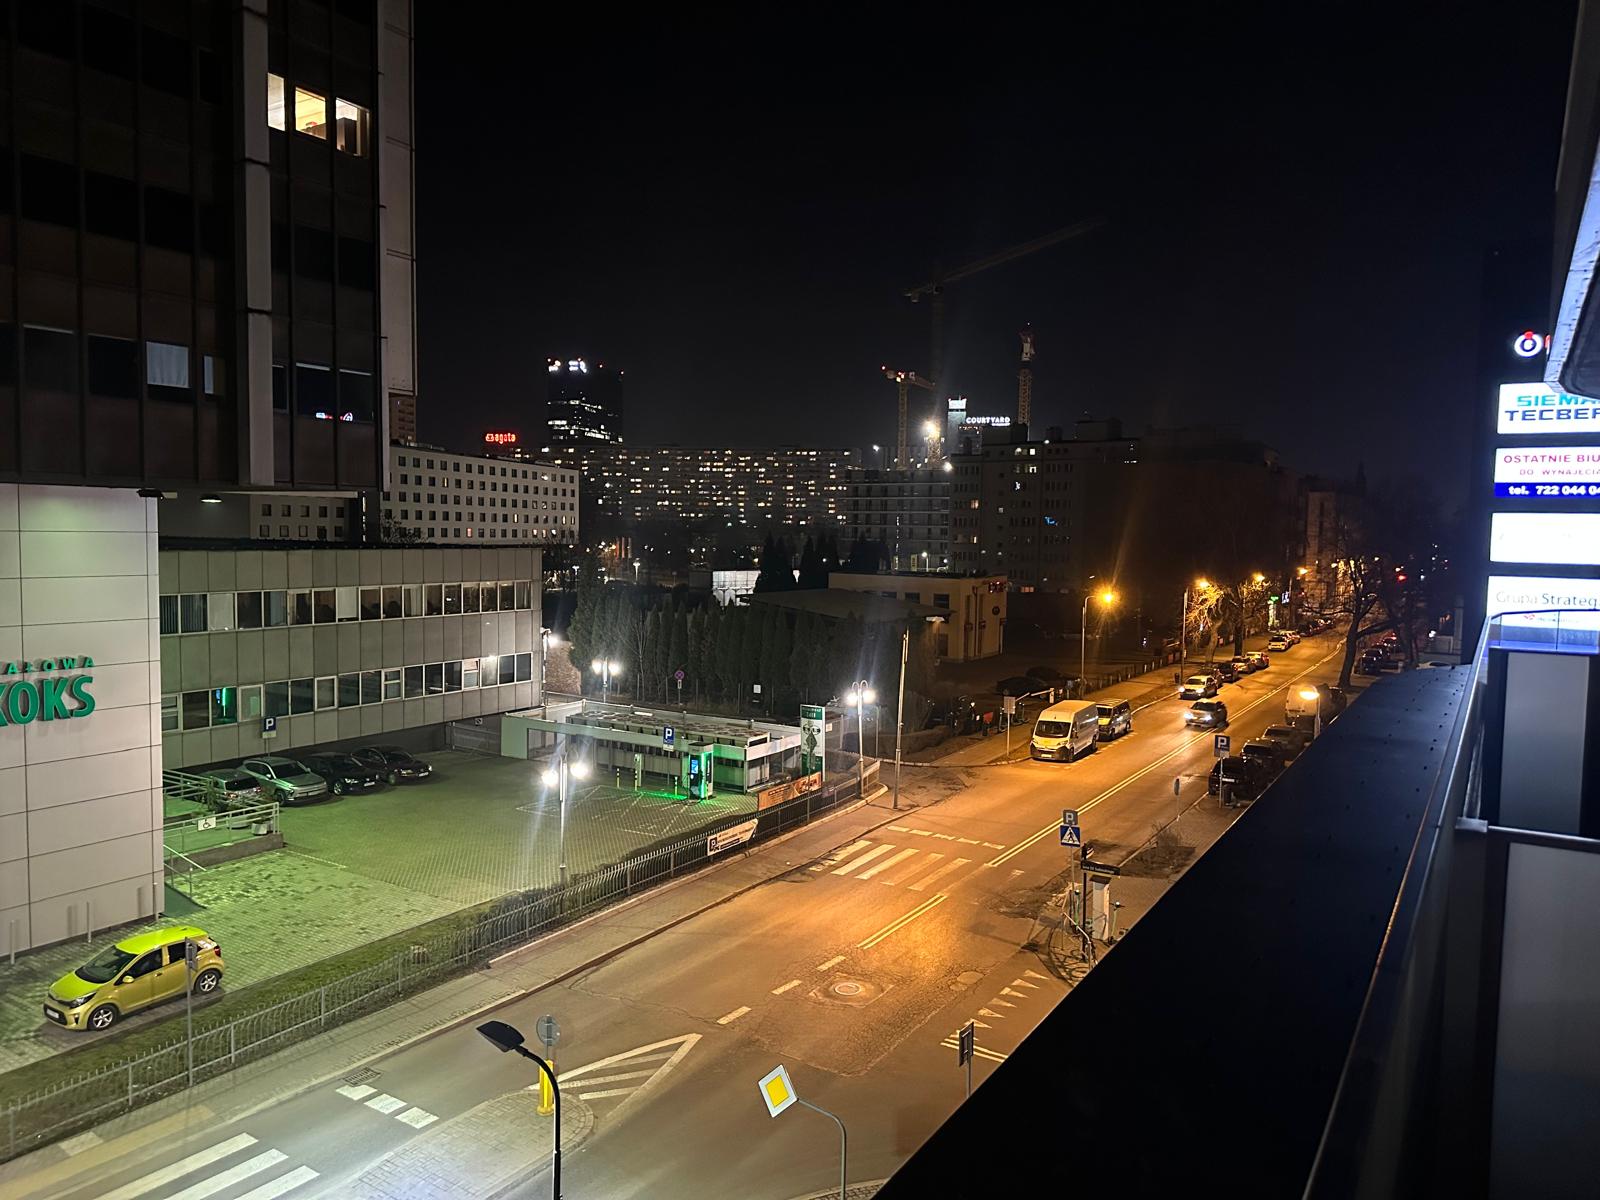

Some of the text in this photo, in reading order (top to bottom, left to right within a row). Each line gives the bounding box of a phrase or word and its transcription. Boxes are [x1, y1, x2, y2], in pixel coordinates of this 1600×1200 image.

[966, 416, 1011, 424] COURTYARD
[1503, 455, 1572, 464] OSTATNIE
[1508, 485, 1600, 495] tel. 722 044 0
[1541, 593, 1600, 610] Strateg
[266, 718, 274, 730] P
[665, 728, 673, 739] P
[1217, 736, 1227, 748] P
